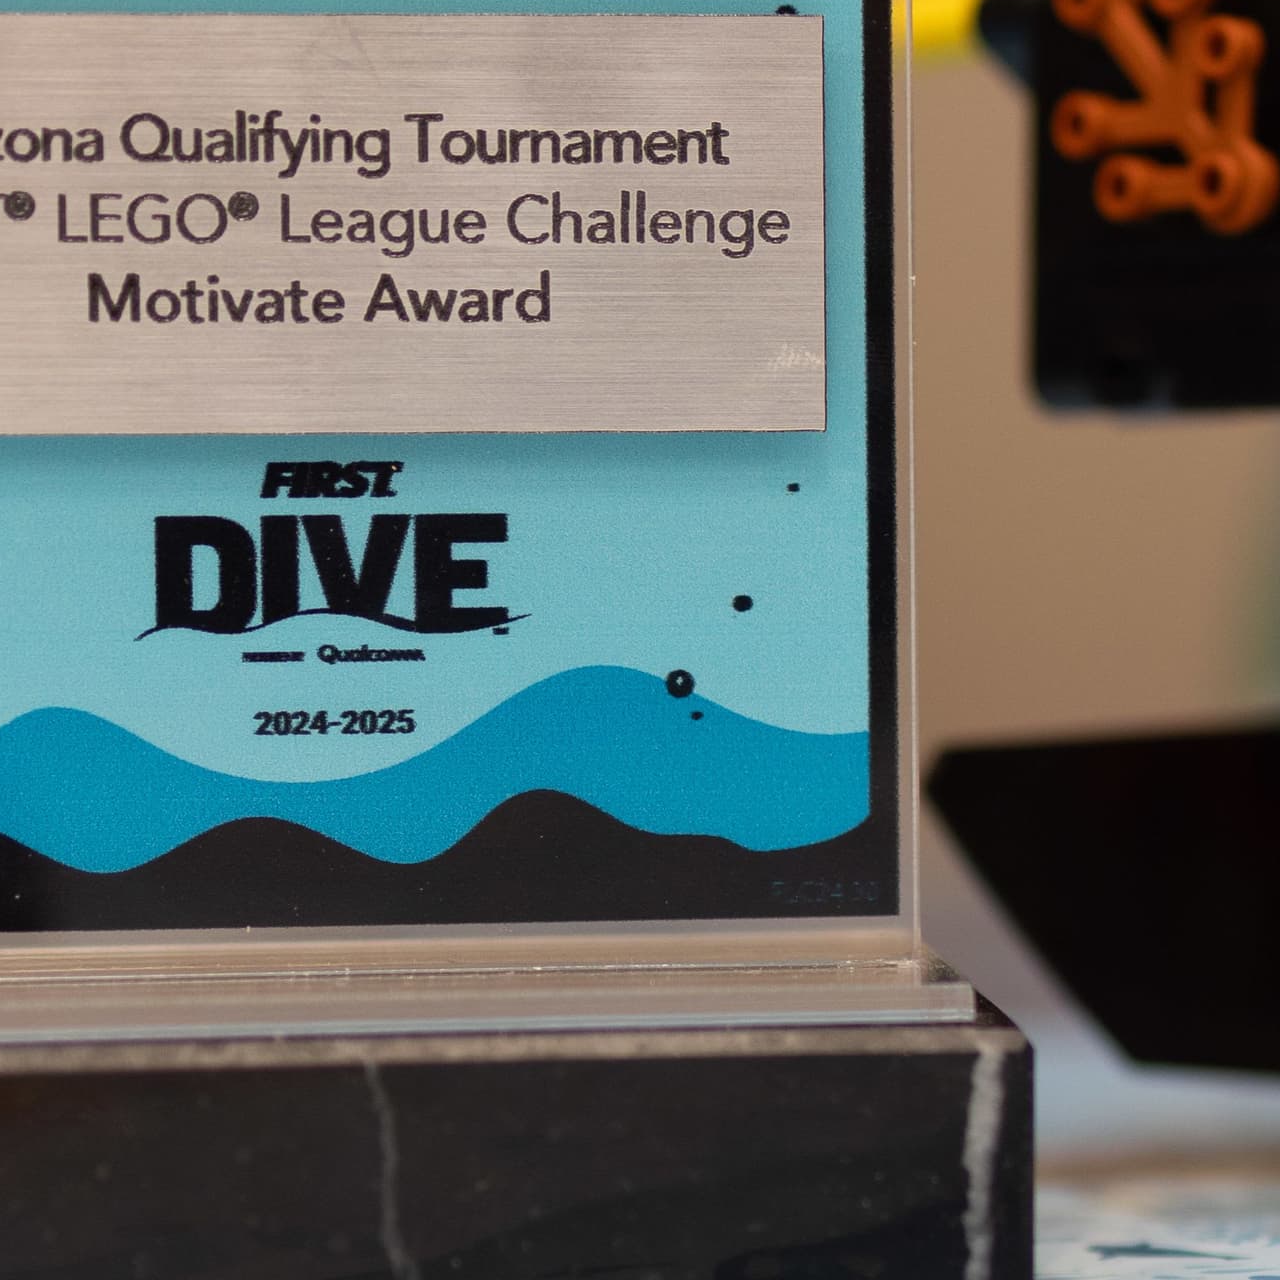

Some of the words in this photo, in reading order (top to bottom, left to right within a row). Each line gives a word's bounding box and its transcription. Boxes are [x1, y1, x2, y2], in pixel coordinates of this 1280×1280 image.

[120, 109, 391, 179] Qualifying
[404, 113, 730, 165] Tournament
[281, 193, 487, 258] League
[507, 190, 790, 258] Challenge
[88, 272, 345, 323] Motivate
[363, 269, 551, 322] Award
[154, 513, 510, 634] DIVE
[253, 709, 417, 736] 2024-2025
